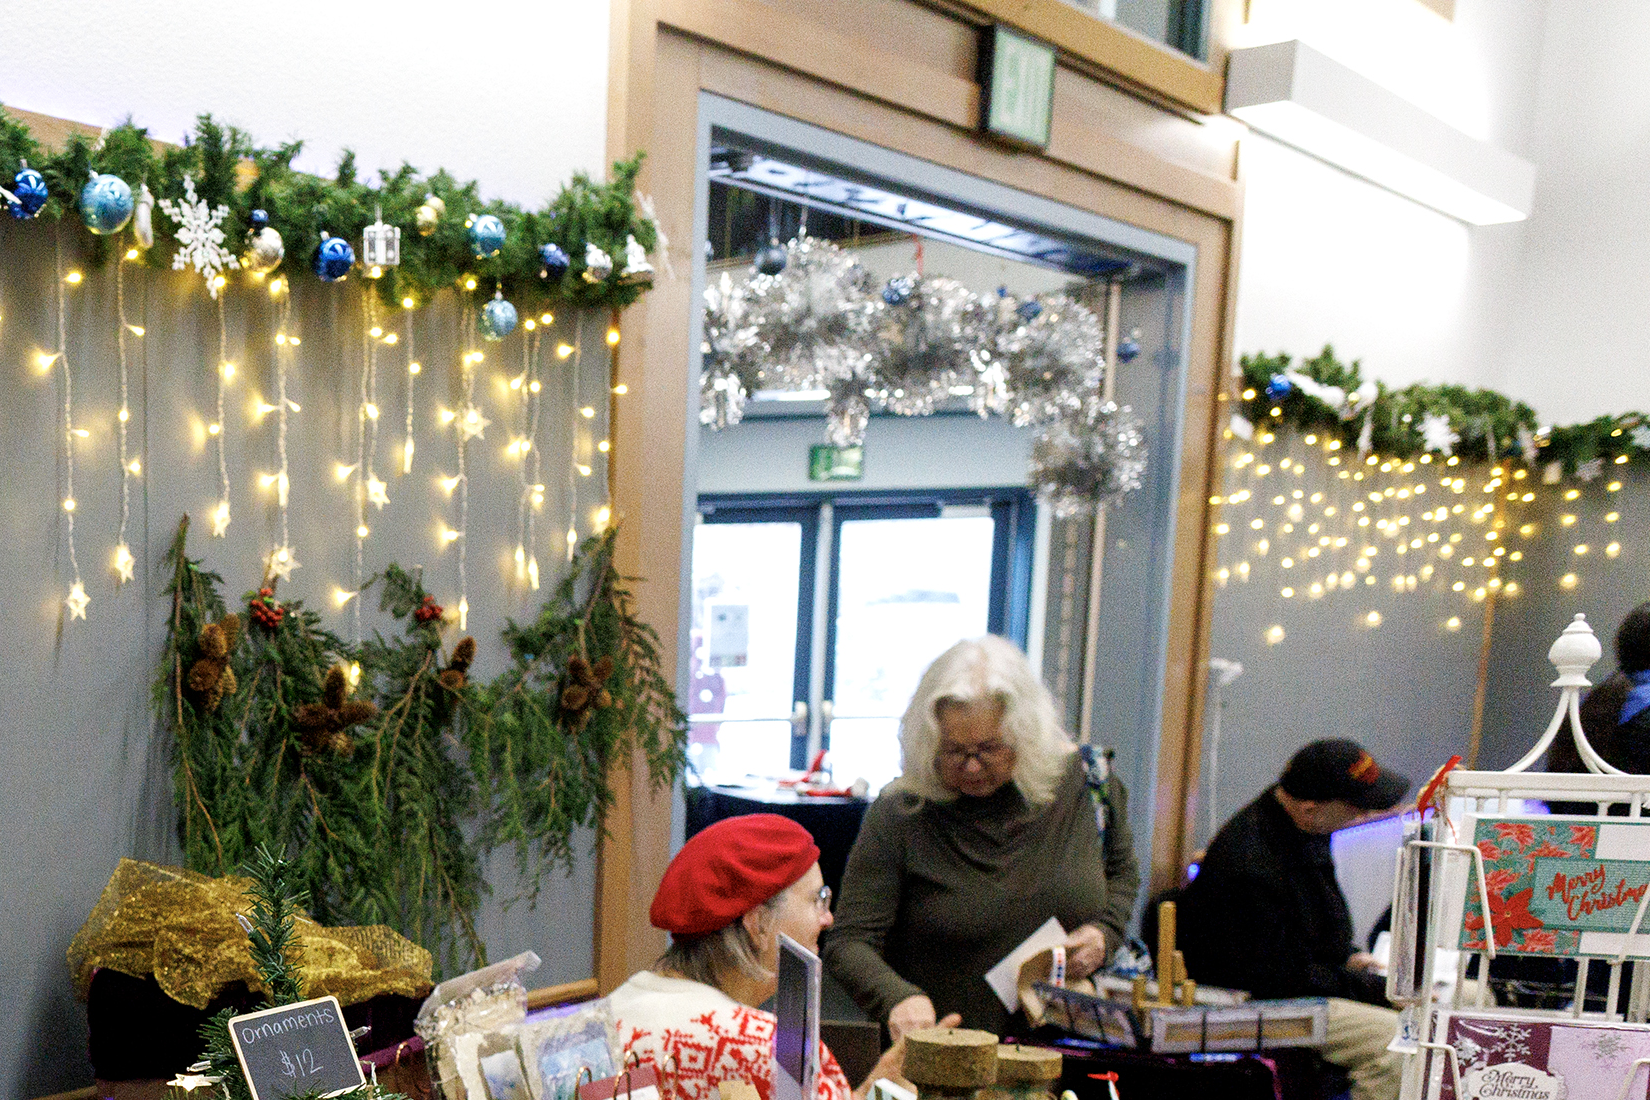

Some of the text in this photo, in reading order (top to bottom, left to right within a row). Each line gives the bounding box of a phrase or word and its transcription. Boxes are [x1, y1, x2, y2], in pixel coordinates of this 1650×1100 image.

[1545, 864, 1606, 904] Merry
[1566, 878, 1649, 921] Christma
[242, 1008, 335, 1044] Ornaments
[279, 1048, 324, 1078] $12
[1481, 1069, 1537, 1089] Merry
[1479, 1083, 1550, 1100] Christmas
